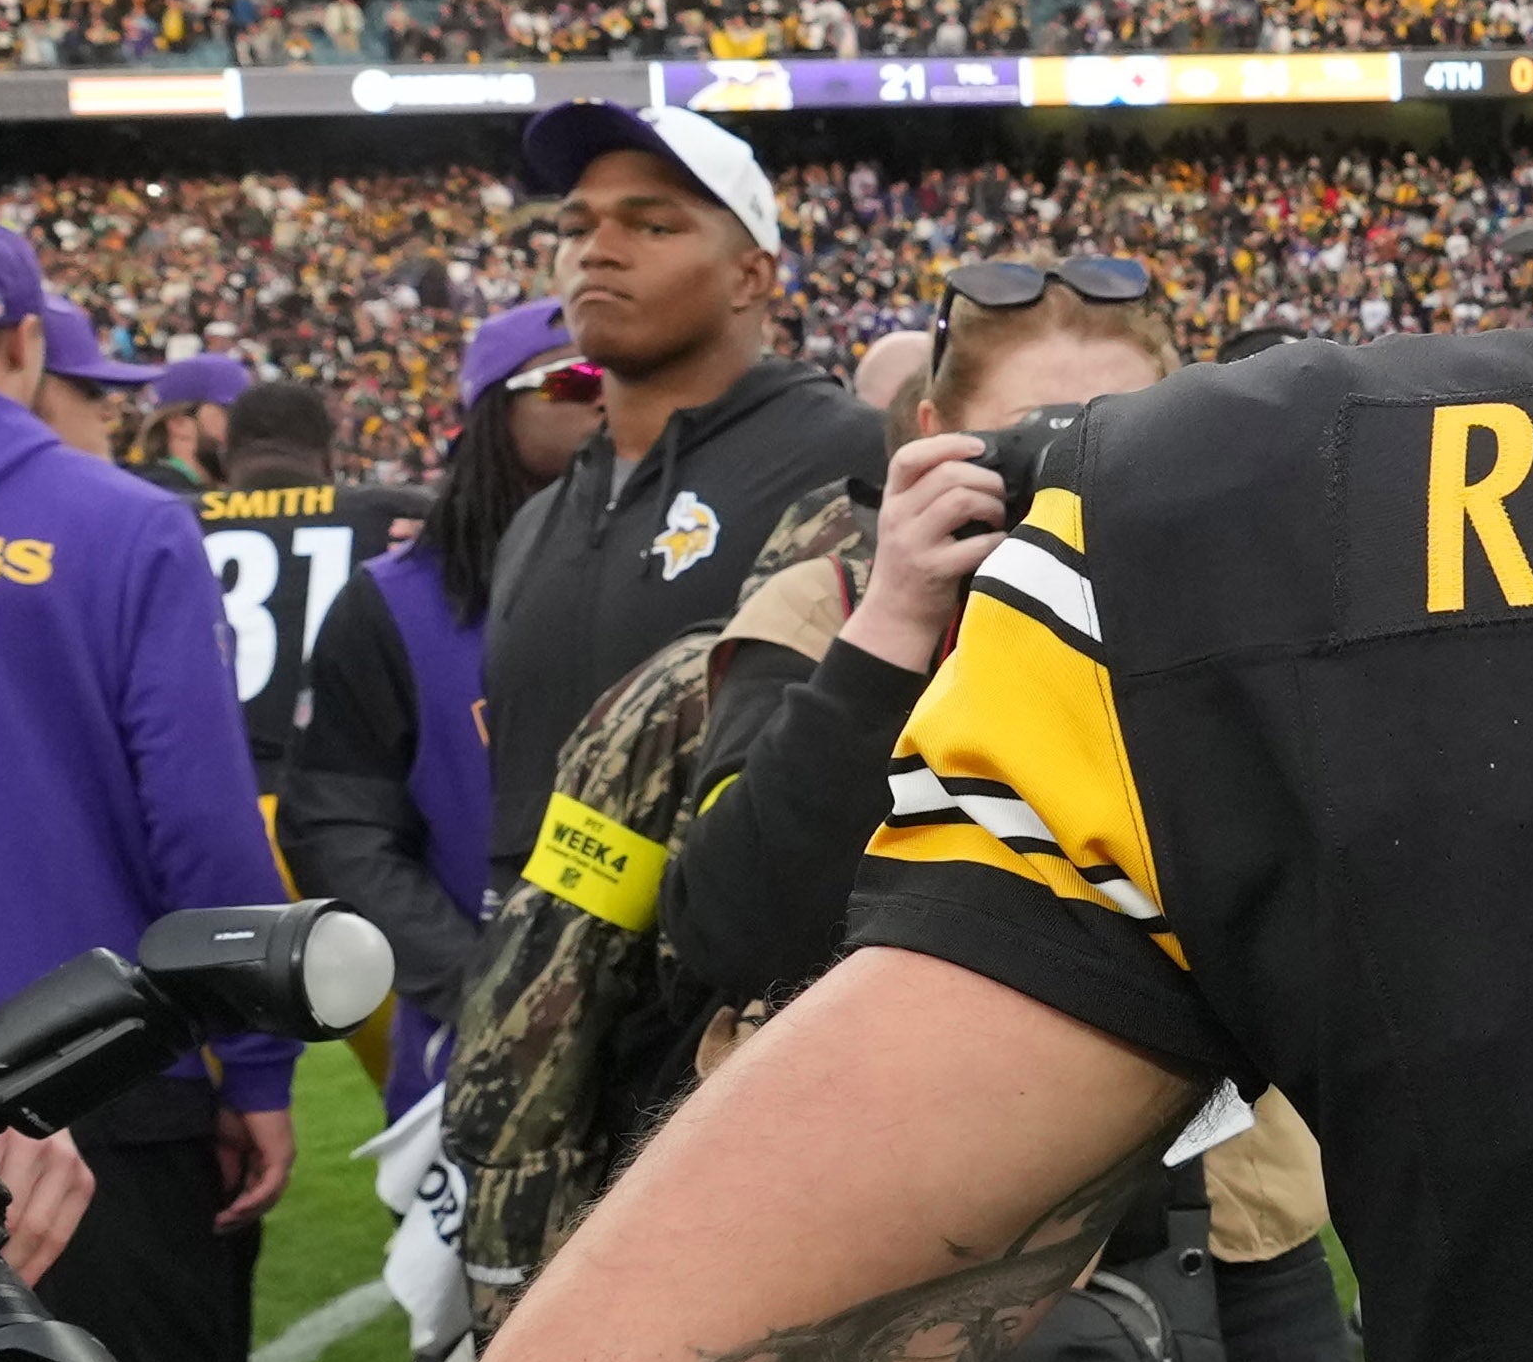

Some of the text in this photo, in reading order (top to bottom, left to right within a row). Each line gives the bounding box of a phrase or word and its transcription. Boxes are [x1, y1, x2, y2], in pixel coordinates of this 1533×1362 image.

[879, 63, 926, 101] 21
[1423, 60, 1483, 92] 4TH
[200, 485, 337, 521] SMITH
[553, 820, 613, 865] WEEK
[610, 854, 629, 873] 4
